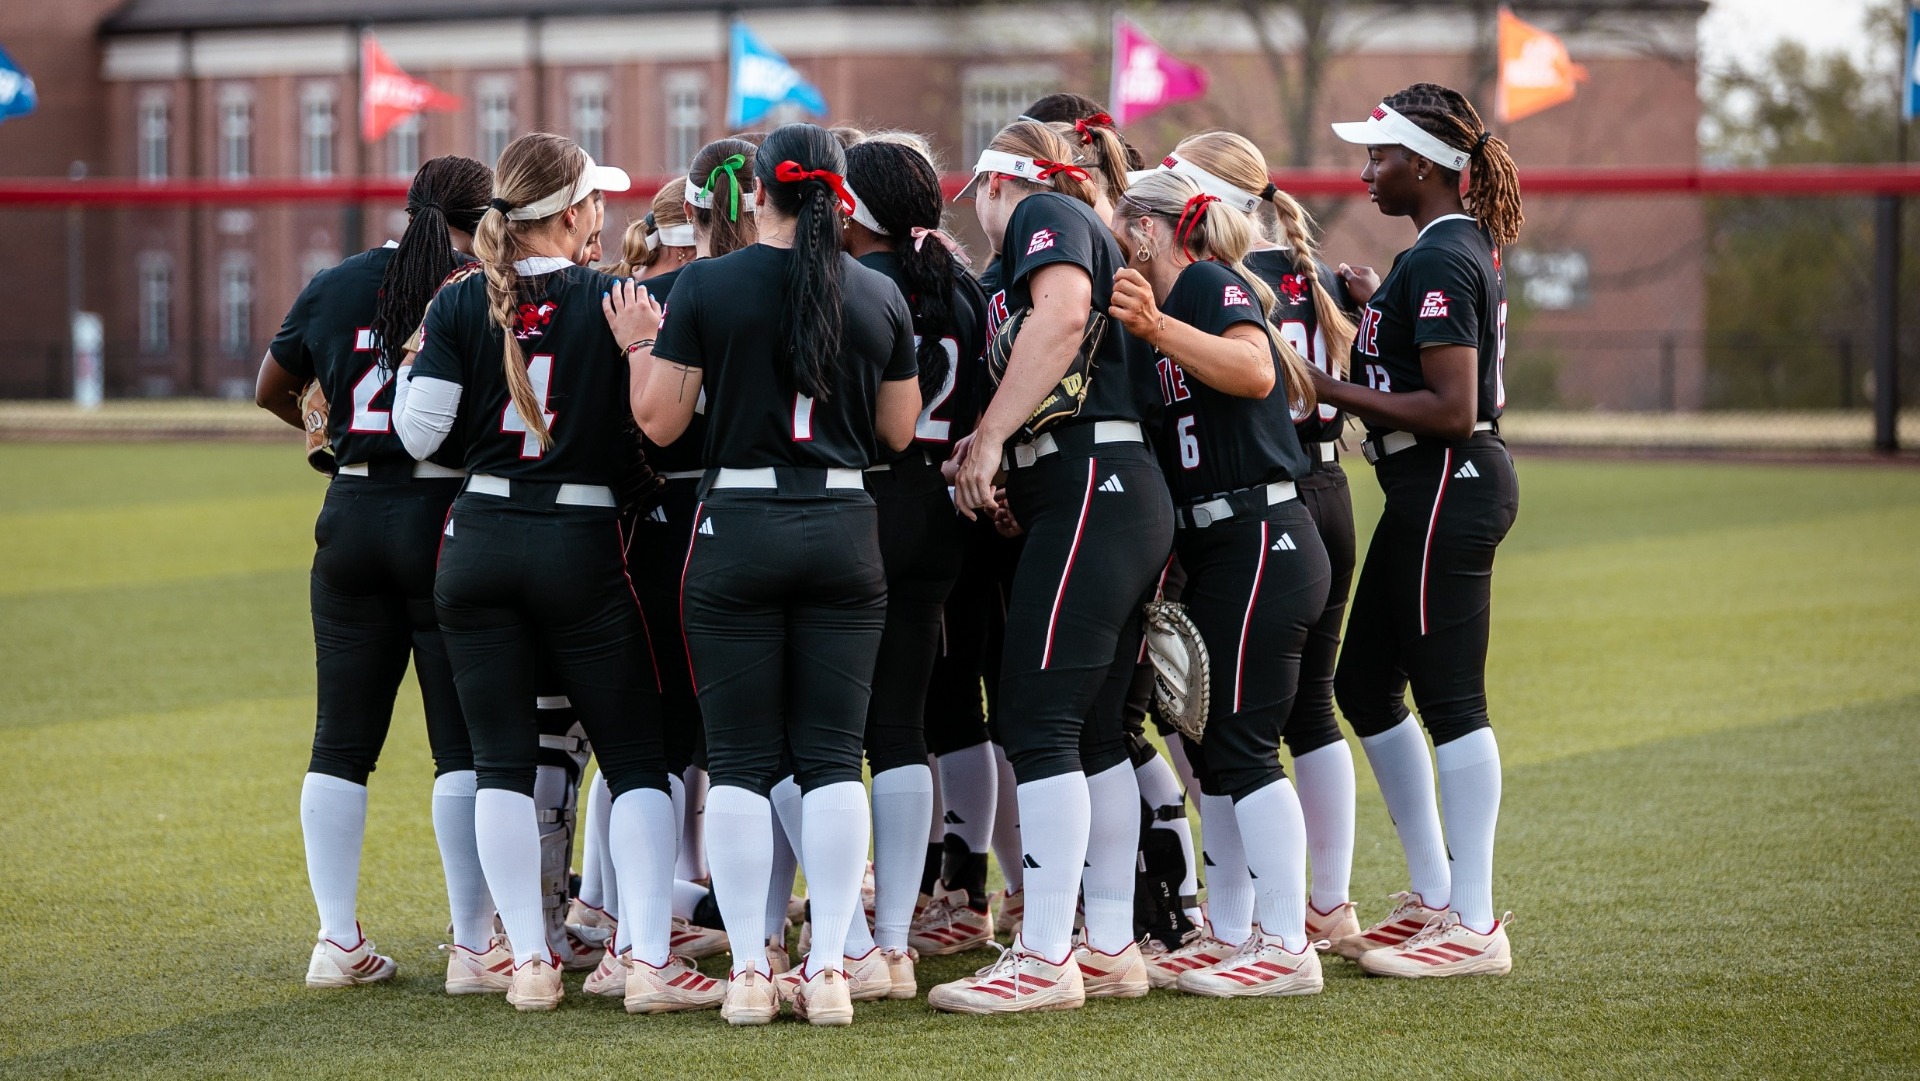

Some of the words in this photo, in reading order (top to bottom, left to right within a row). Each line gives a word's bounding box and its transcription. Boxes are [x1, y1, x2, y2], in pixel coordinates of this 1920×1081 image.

[1026, 239, 1055, 256] USA
[1223, 297, 1252, 307] USA
[1419, 306, 1449, 319] USA
[497, 353, 558, 460] 4
[1176, 414, 1201, 470] 6
